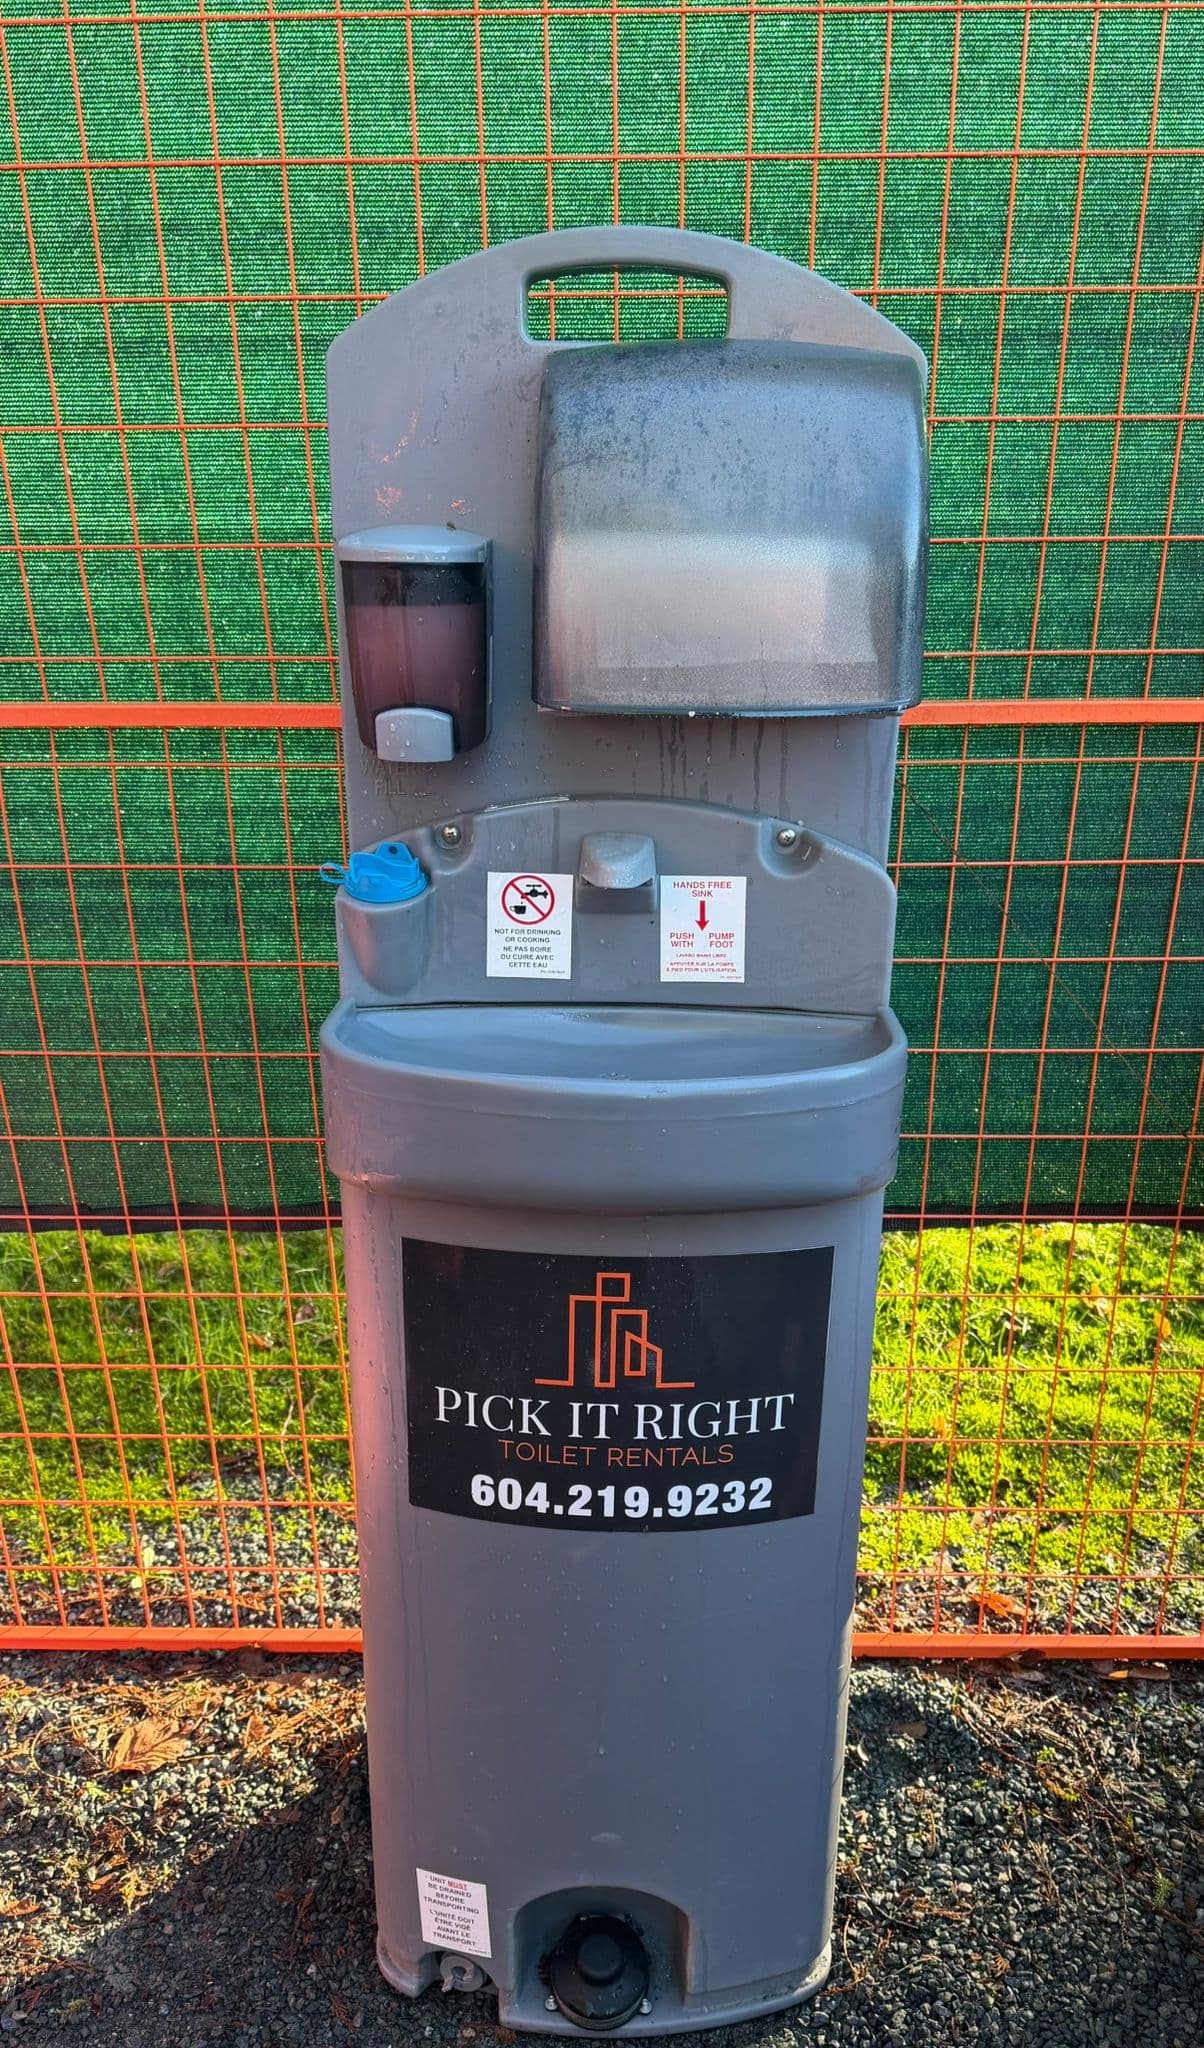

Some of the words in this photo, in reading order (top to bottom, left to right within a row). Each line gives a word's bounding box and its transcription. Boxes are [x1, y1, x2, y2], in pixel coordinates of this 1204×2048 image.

[375, 779, 406, 795] FILL
[673, 881, 705, 889] HANDS
[708, 881, 732, 889] FREE
[670, 932, 694, 940] PUSH
[709, 932, 735, 940] PUMP
[434, 1386, 552, 1438] PICK
[568, 1402, 620, 1440] IT
[632, 1392, 795, 1440] RIGHT
[498, 1439, 597, 1466] TOILET
[608, 1444, 734, 1467] RENTALS
[470, 1474, 773, 1518] 604.219.9232
[428, 1882, 438, 1890] BE
[440, 1886, 472, 1898] DRAINED
[430, 1875, 446, 1884] UNIT
[448, 1881, 468, 1890] MUST
[424, 1896, 479, 1914] TRANSPORTING
[436, 1892, 465, 1904] BEFORE
[458, 1916, 474, 1924] DOIT
[437, 1926, 459, 1935] AVANT
[432, 1931, 475, 1946] TRANSPORT
